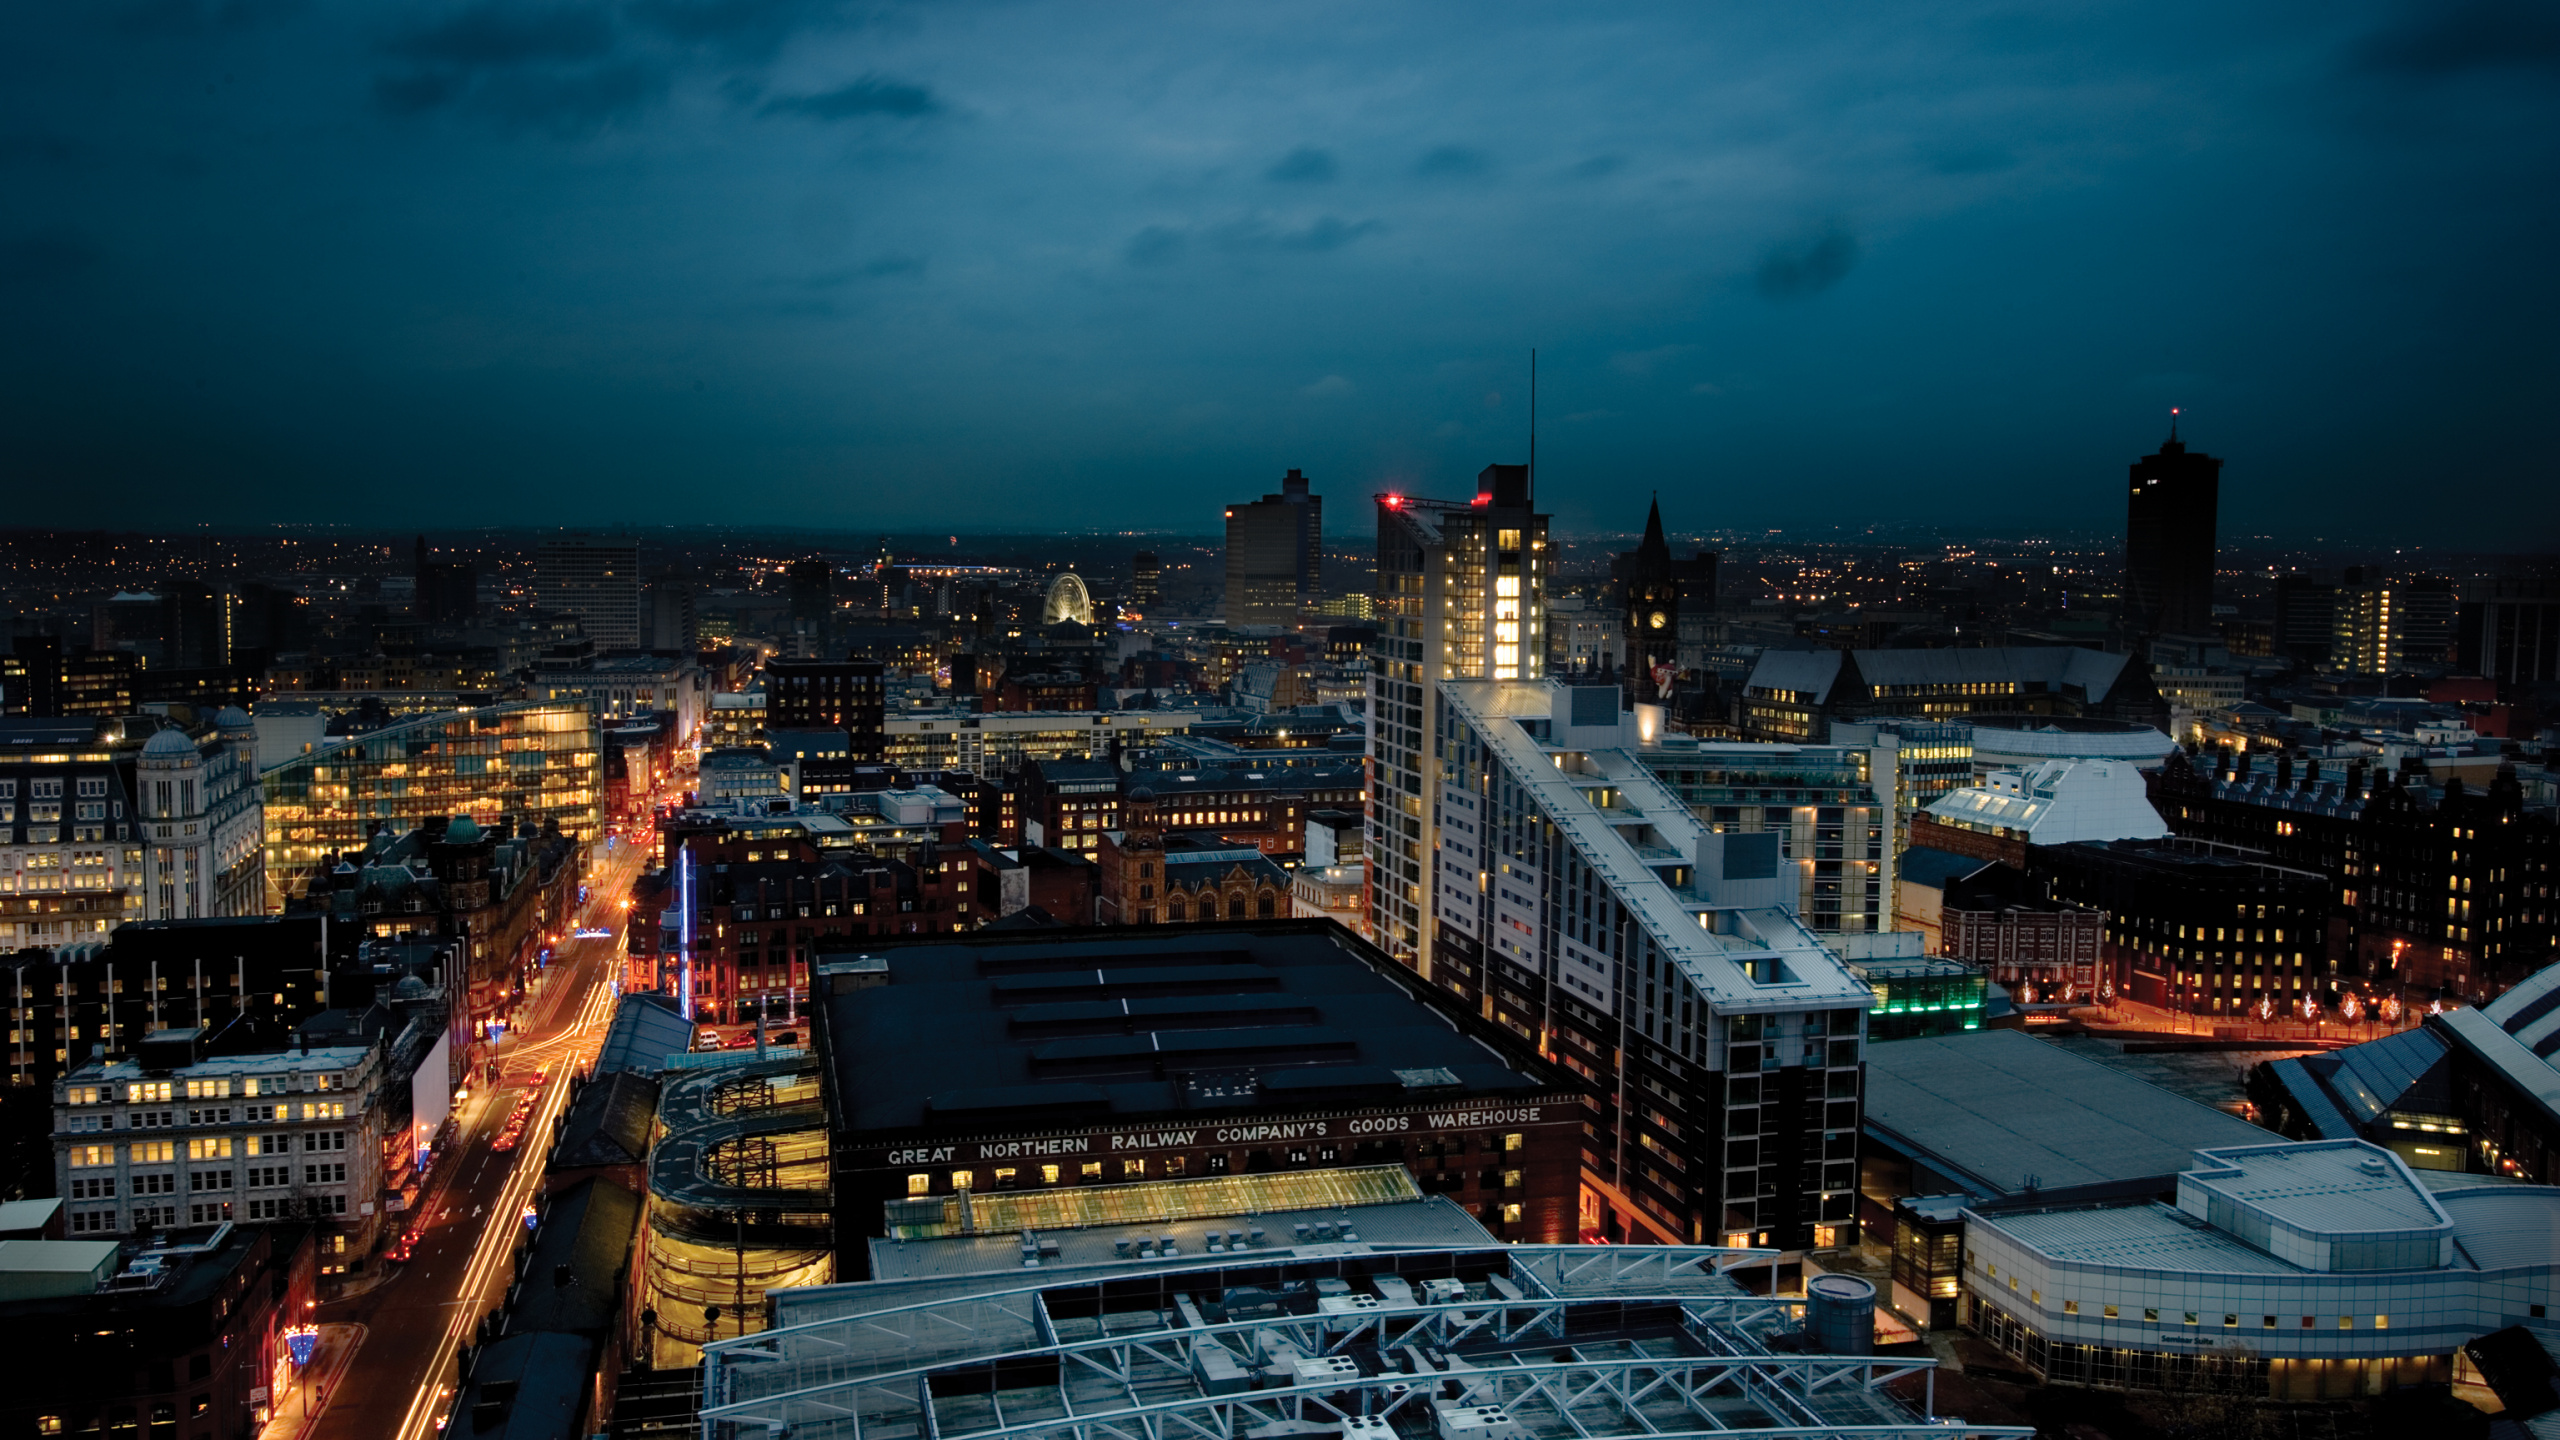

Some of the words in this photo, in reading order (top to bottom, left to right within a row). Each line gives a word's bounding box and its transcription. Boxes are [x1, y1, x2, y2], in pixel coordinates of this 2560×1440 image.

[889, 1146, 956, 1165] GREAT
[980, 1137, 1088, 1159] NORTHERN
[1111, 1130, 1198, 1150] RAILWAY
[1216, 1121, 1327, 1143] COMPANY'S
[1349, 1116, 1410, 1134] GOODS
[1428, 1107, 1541, 1129] WAREHOUSE
[2161, 1335, 2193, 1344] Seminar
[2194, 1337, 2214, 1345] Suite
